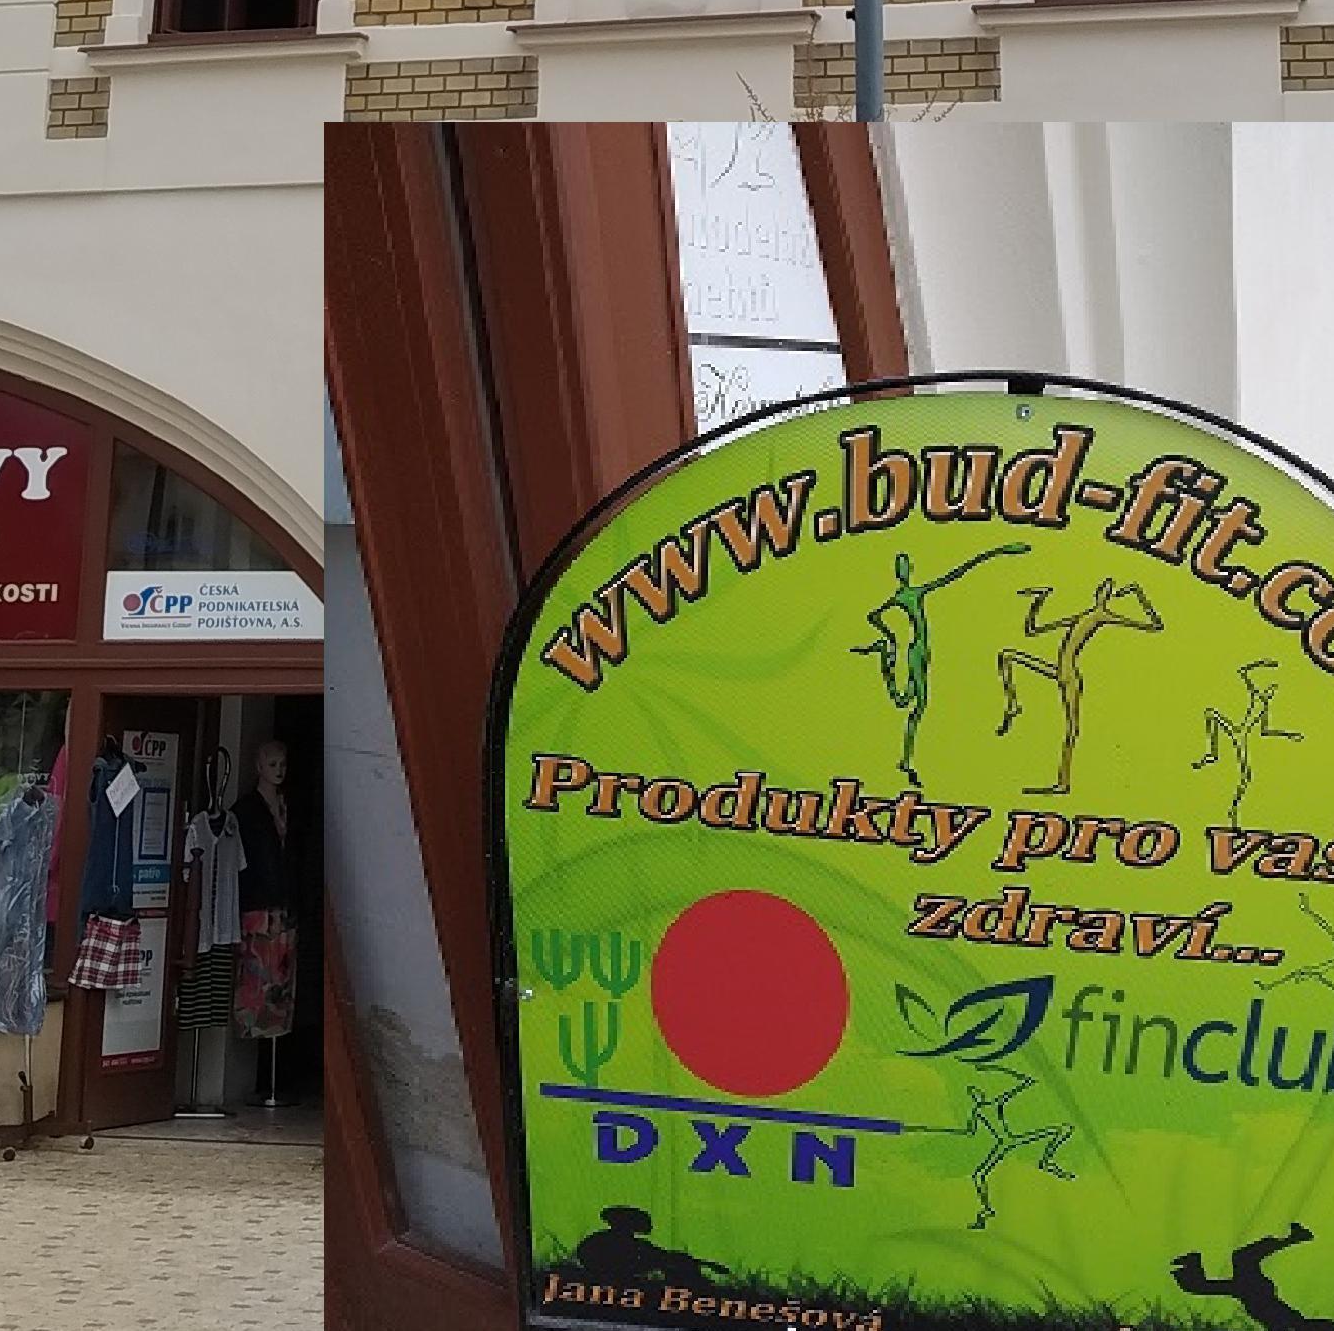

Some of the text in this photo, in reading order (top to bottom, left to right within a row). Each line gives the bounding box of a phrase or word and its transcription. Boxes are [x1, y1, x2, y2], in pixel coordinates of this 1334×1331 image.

[149, 585, 193, 614] ČPP
[199, 583, 240, 597] ČESKÁ
[198, 598, 300, 613] PODNIKATELSKÁ
[280, 616, 304, 629] A.S.
[526, 753, 994, 864] Produkty
[993, 806, 1180, 876] pro
[905, 885, 1286, 967] zdraví...
[542, 1272, 646, 1310] Jana
